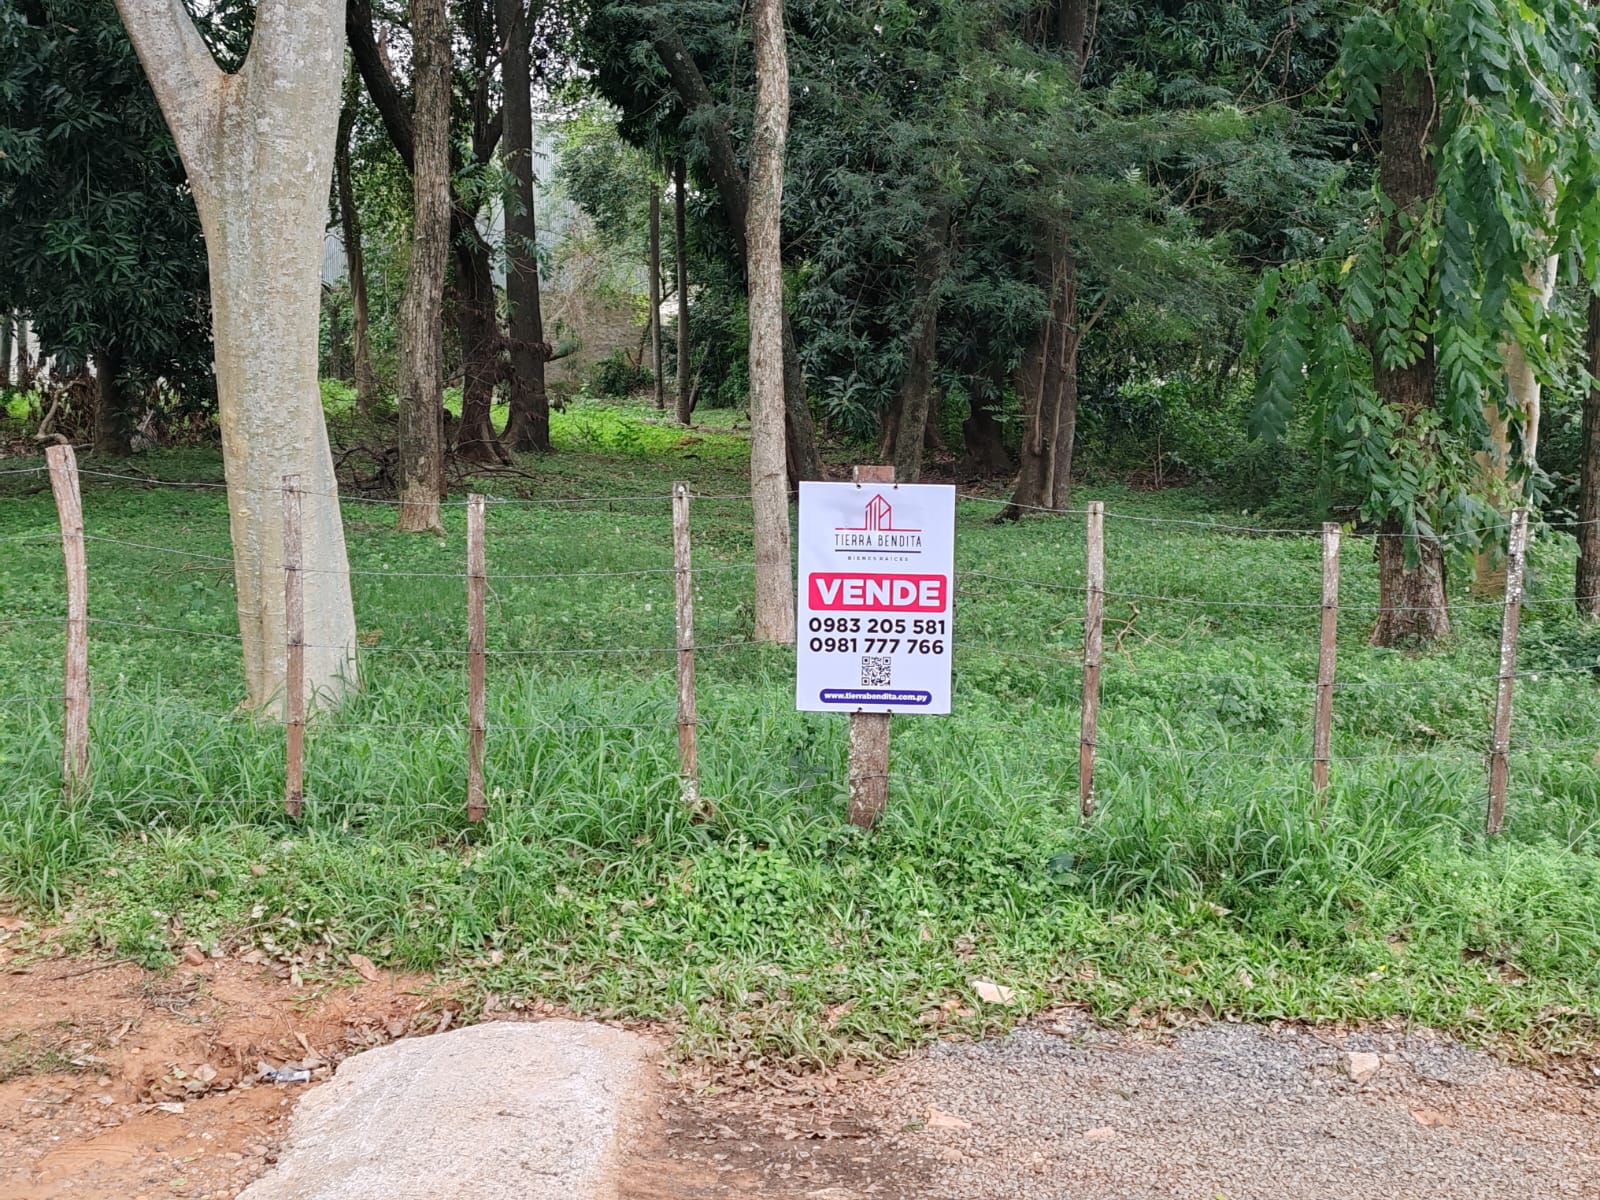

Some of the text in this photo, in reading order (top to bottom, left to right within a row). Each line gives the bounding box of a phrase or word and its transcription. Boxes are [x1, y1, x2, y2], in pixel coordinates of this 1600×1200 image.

[835, 534, 922, 547] TIERRA BENDITA
[815, 578, 941, 607] VENDE
[809, 617, 945, 635] 0983 205 581
[809, 637, 944, 655] 0981 777 766
[824, 692, 928, 702] www.tierrabendita.com.py
